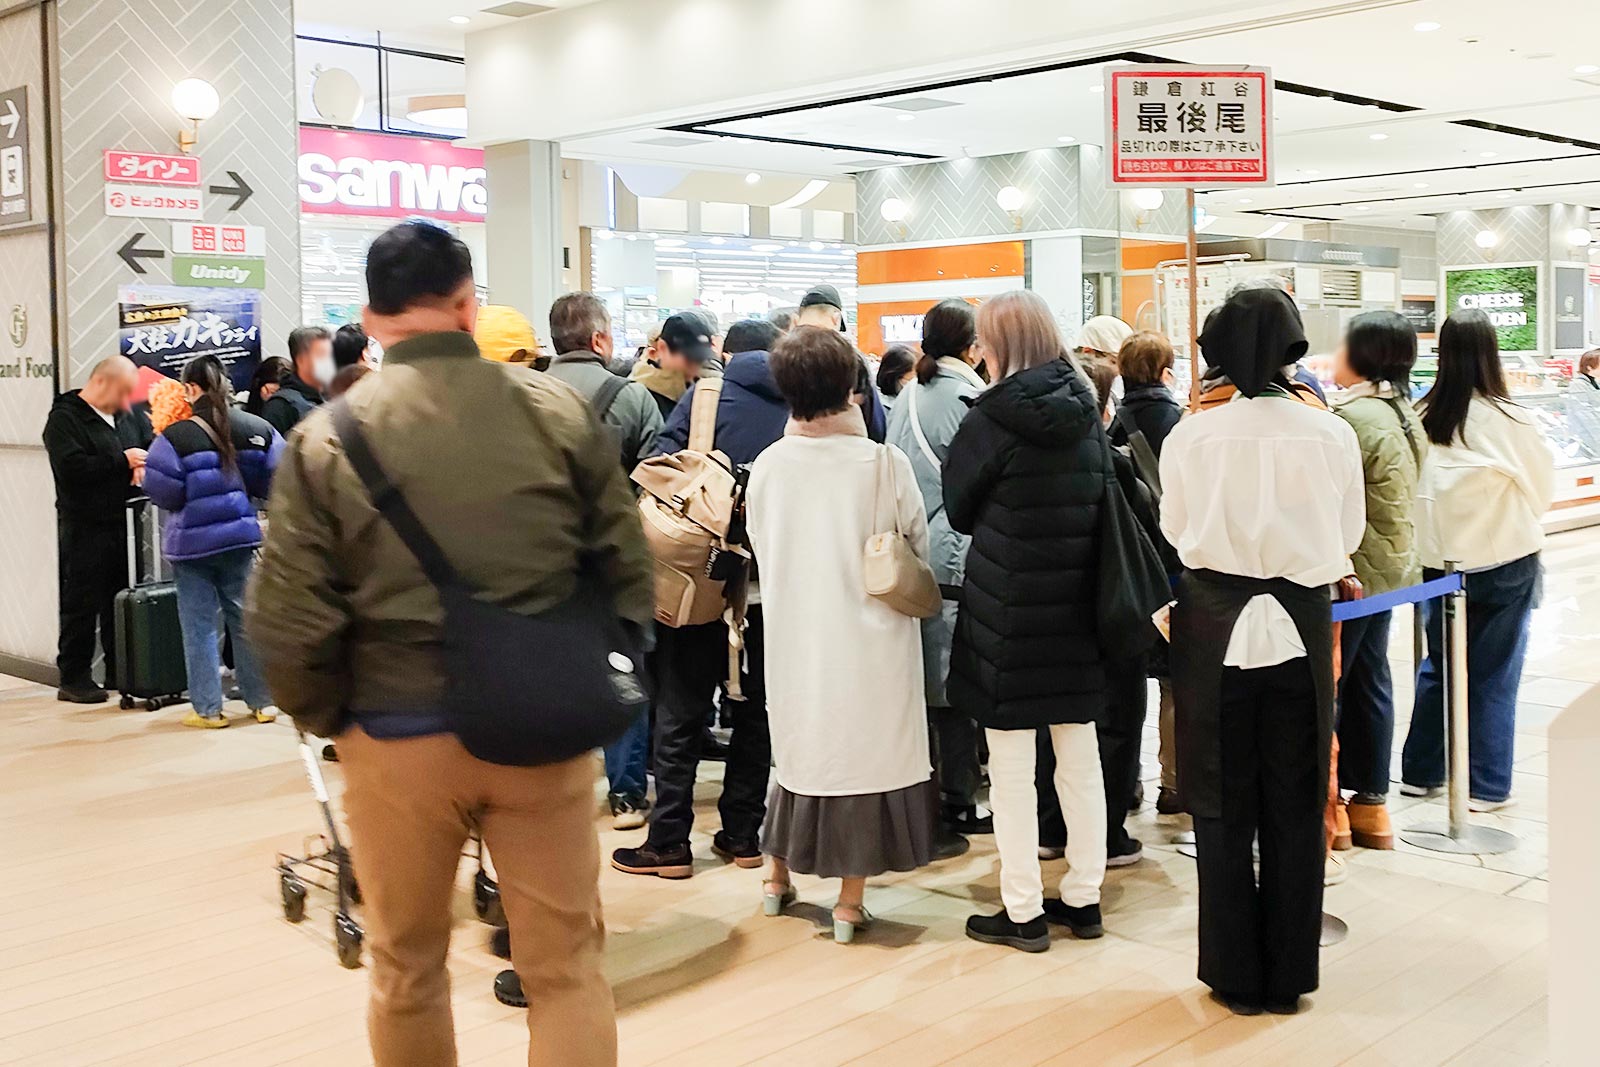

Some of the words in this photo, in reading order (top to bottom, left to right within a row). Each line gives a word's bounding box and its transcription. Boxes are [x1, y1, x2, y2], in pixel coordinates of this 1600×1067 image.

[1133, 81, 1249, 97] 鎌倉紅谷
[1137, 101, 1246, 134] 最後尾
[1120, 139, 1260, 153] 品切れの際はご了承下さい
[118, 156, 189, 179] ダイソー
[190, 264, 251, 283] Unidy
[1458, 292, 1525, 309] CHEESE
[1490, 311, 1528, 326] DEN
